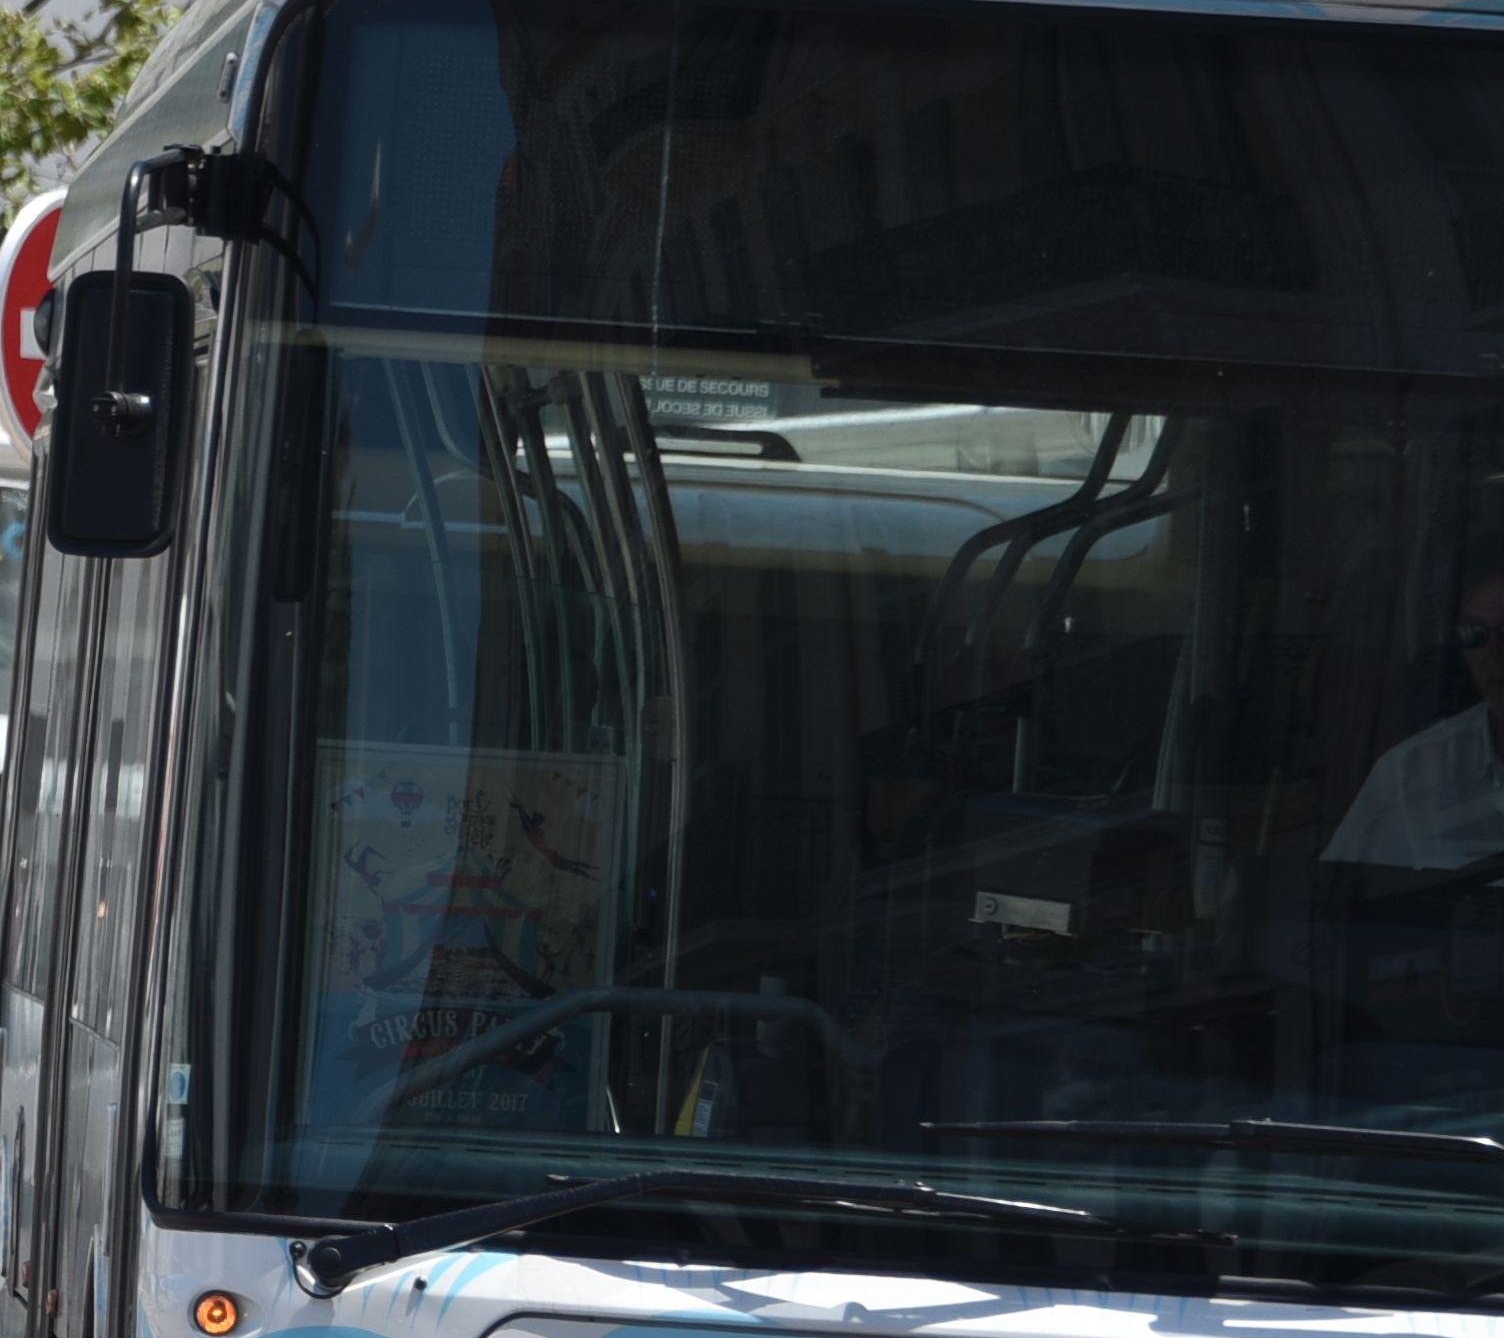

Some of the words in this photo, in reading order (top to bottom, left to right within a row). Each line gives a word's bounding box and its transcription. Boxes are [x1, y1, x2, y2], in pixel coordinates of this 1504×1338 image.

[677, 379, 698, 394] DE
[699, 380, 770, 398] SECOURS
[369, 1009, 458, 1050] CIRCUS
[488, 1091, 528, 1112] 2017
